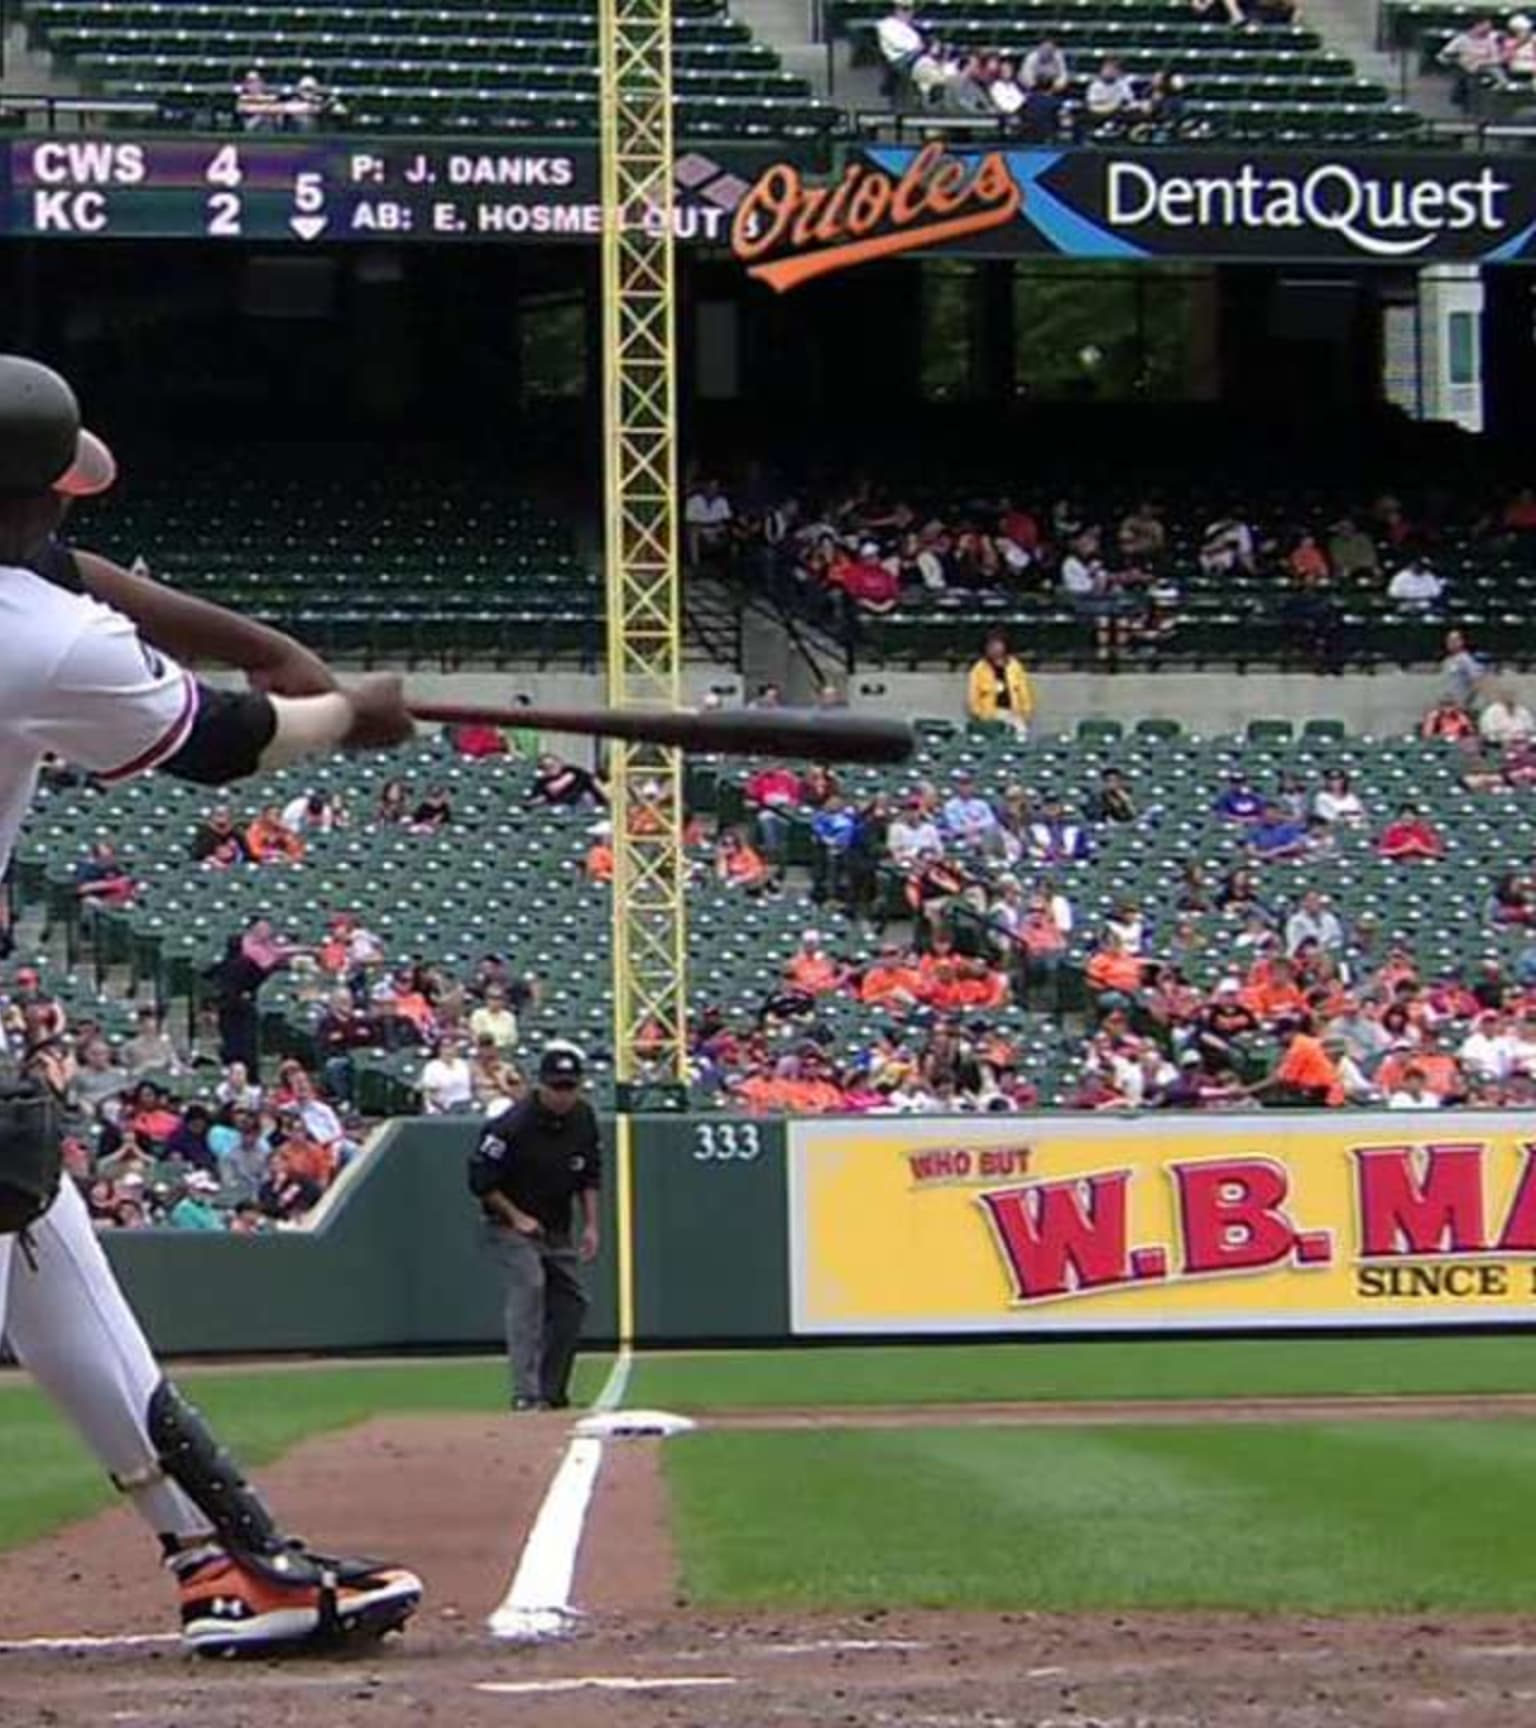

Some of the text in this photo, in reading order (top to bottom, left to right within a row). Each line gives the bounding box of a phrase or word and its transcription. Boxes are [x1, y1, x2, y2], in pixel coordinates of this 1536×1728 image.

[33, 143, 243, 187] CWS 4
[352, 154, 573, 186] P: J. DANKS
[294, 173, 324, 212] 5
[732, 142, 1022, 260] Orioles
[1107, 161, 1511, 254] DentaQuest
[34, 191, 242, 235] KC 2
[352, 202, 626, 234] AB: E. HOSME
[693, 1125, 761, 1161] 333
[910, 1150, 1031, 1180] WHO BUT
[979, 1156, 1333, 1301] W.B.
[1357, 1263, 1509, 1298] SINCE
